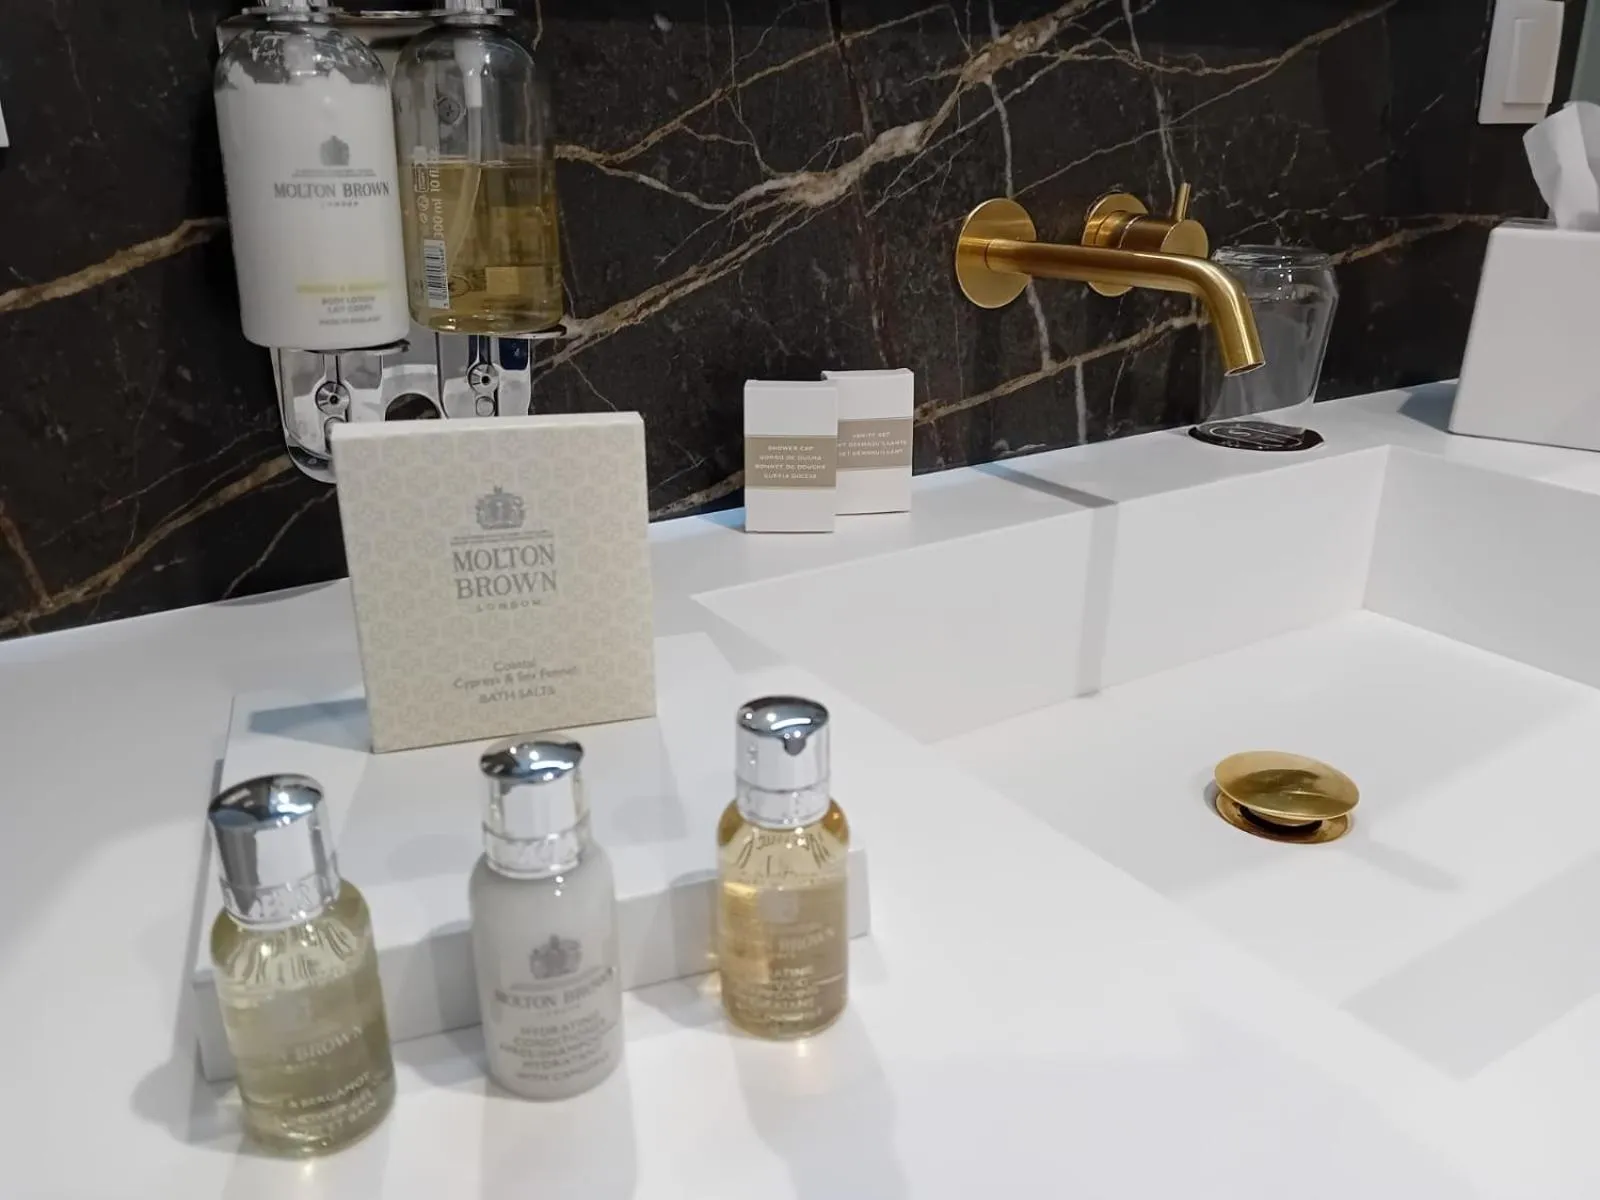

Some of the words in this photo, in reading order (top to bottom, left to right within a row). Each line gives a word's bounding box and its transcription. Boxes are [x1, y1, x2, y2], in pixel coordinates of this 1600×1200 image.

[273, 182, 336, 199] MOLTON
[342, 179, 390, 199] BROWN
[452, 543, 555, 573] MOLTON
[454, 569, 557, 600] BROWN
[479, 690, 516, 704] BATH
[518, 685, 557, 700] SALTS
[294, 1024, 363, 1062] BROWN
